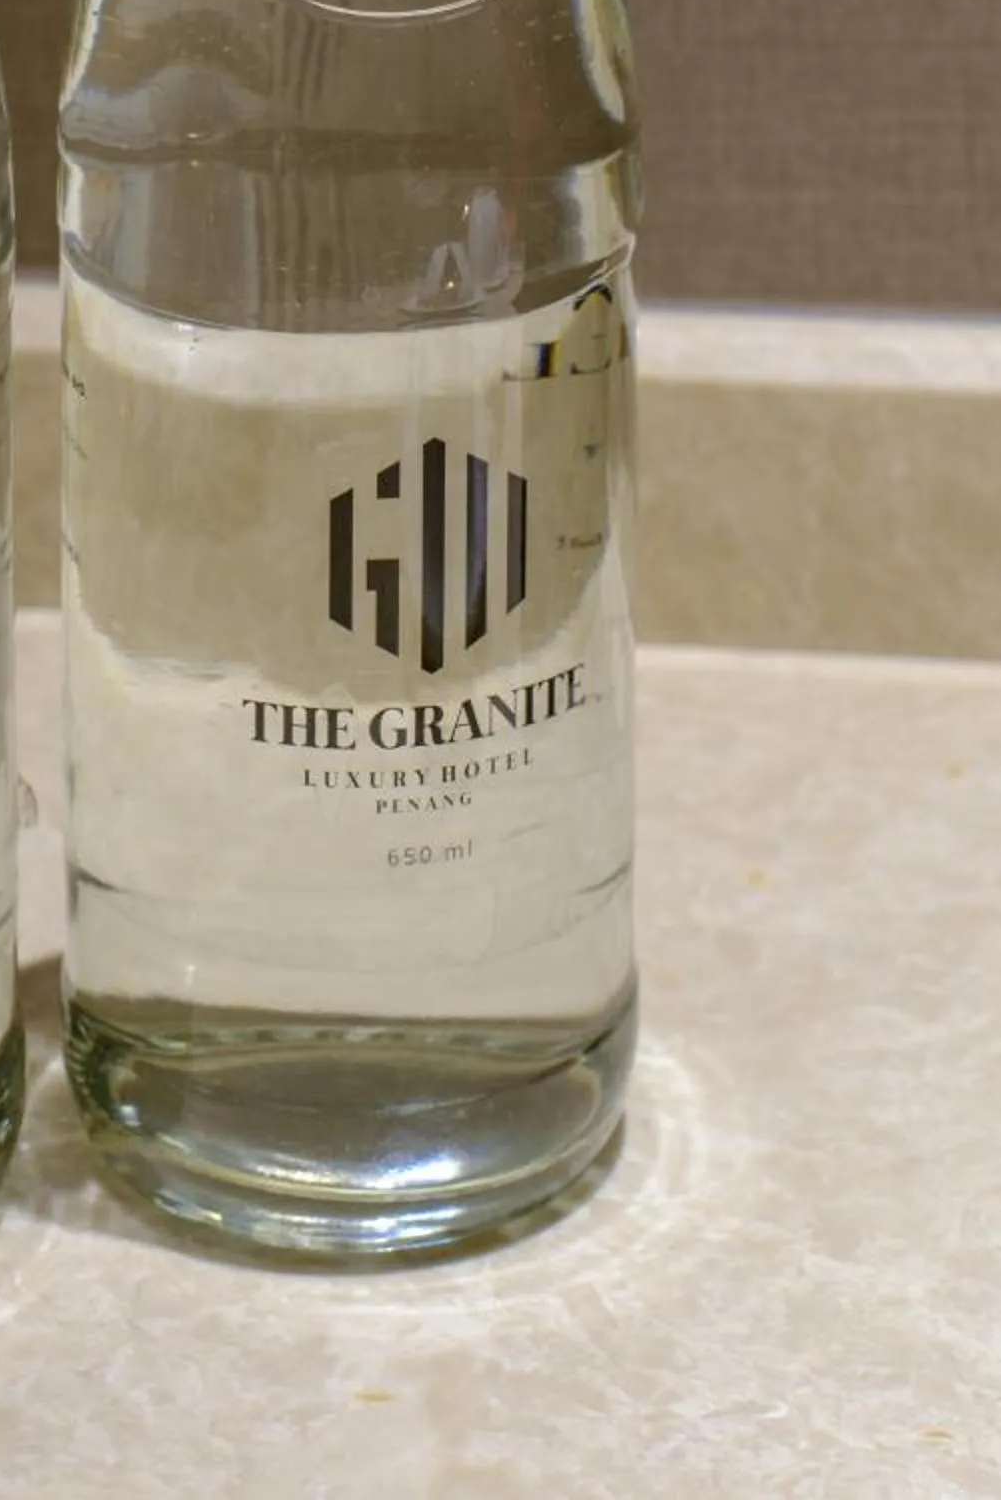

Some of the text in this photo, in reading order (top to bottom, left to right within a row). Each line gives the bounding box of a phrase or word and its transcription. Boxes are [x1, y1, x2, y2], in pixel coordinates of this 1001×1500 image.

[241, 662, 587, 752] THE GRANITE
[303, 746, 535, 790] LUXURY HOTEL
[375, 790, 473, 815] PENANG
[386, 839, 474, 868] 650 ml
